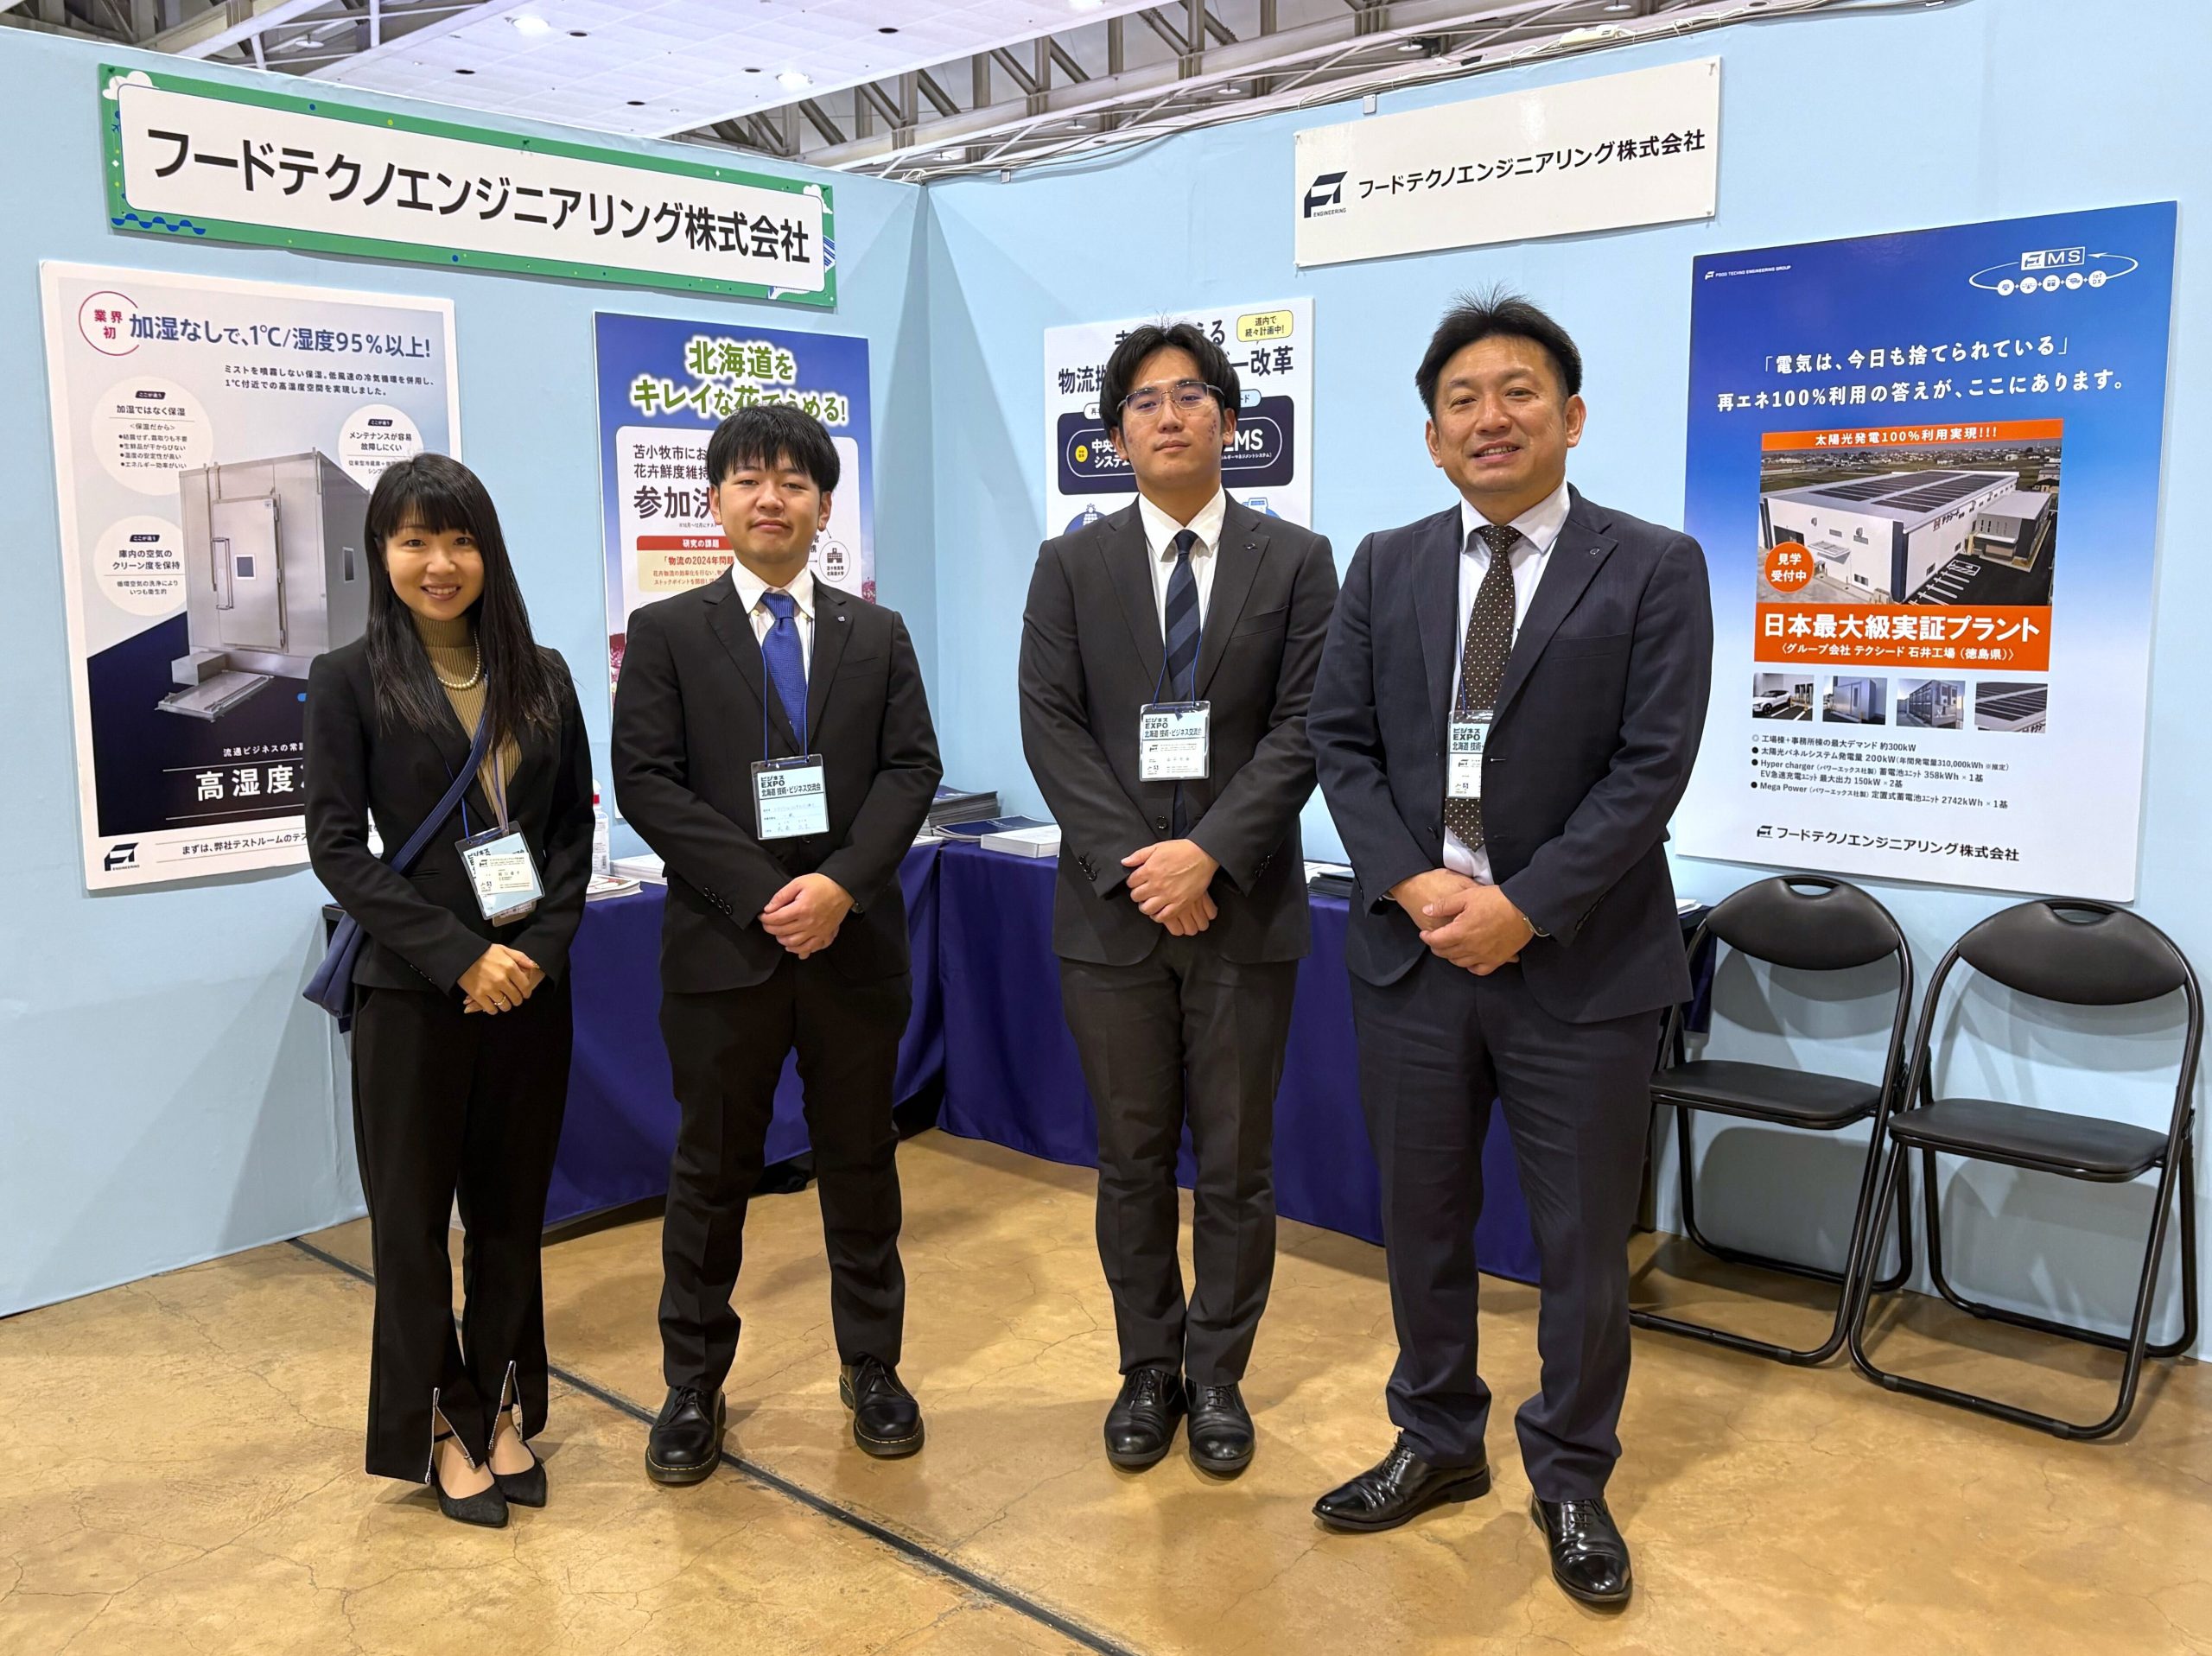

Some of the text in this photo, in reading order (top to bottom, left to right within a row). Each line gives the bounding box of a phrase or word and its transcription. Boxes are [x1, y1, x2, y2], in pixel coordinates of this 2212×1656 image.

[1358, 128, 1706, 200] フードテクノエンジニアリング株式会社
[147, 129, 810, 263] フードテクノエンジニアリング株式会社
[1313, 207, 1347, 218] ENGINEERING
[94, 309, 123, 324] 業界
[1255, 315, 1277, 326] 道内で
[103, 327, 117, 339] 初
[1245, 325, 1285, 337] 続々計画中!
[690, 339, 794, 380] 北海道を
[1227, 346, 1294, 377] ー改革
[1764, 336, 2069, 374] 「電気は、今日も捨てられている」
[1717, 369, 2123, 412] 再エネ100%利用の答えが、ここにあります。
[349, 432, 412, 441] メンテナンスが容易
[1224, 428, 1263, 452] MS
[1815, 427, 1997, 446] 太陽光発電100%利用実現!!!
[360, 442, 403, 452] 故障しにくい
[1091, 438, 1117, 454] 中央
[682, 539, 720, 549] 研究の課題
[118, 549, 173, 559] 庫内の空気の
[1777, 553, 1802, 566] 見学
[112, 561, 180, 570] クリーン度を保持
[1770, 569, 1807, 583] 受付中
[1764, 612, 2040, 643] 日本最大級実証プラント
[1853, 644, 1904, 657] テクシード
[1908, 646, 1955, 659] 石井工場
[1452, 742, 1469, 751] 北海道
[1879, 742, 1916, 752] 約300kW
[1761, 747, 1863, 762] 太陽光パネルシステム発電量
[1760, 759, 1783, 769] Hyper
[1784, 761, 1815, 771] charger
[1923, 771, 1959, 781] 358kWh
[1969, 773, 1984, 783] 1基
[195, 765, 304, 802] 高湿度
[1819, 774, 1852, 784] 最大出力
[1854, 777, 1881, 786] 150kW
[1889, 779, 1903, 788] 2基
[761, 788, 776, 797] 北海道
[1760, 782, 1781, 791] Mega
[1783, 784, 1808, 793] Power
[1942, 796, 1983, 807] 2742kWh
[1993, 800, 2008, 809] 1基
[1777, 827, 2019, 861] フードテクノエンジニアリング株式会社
